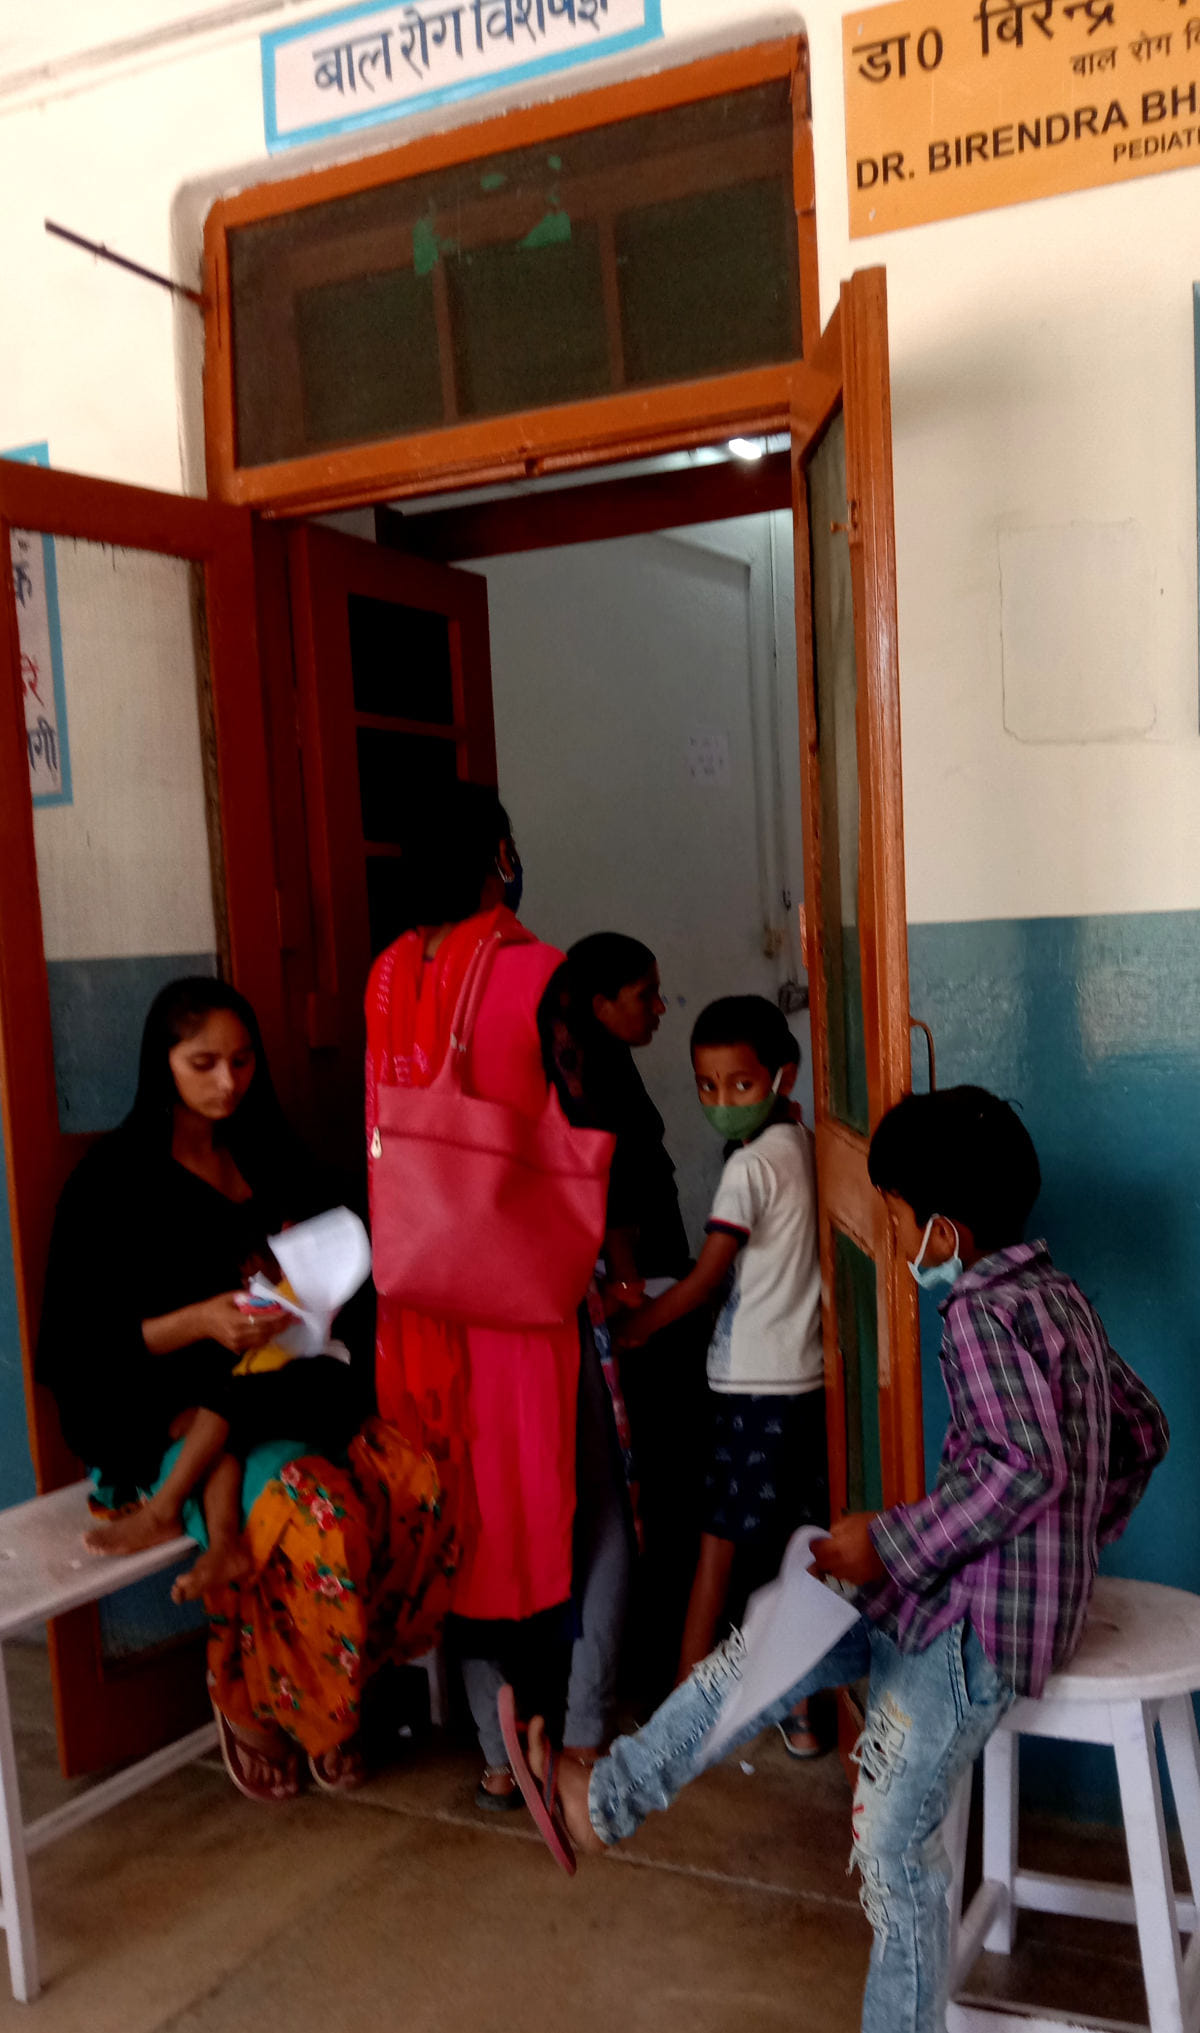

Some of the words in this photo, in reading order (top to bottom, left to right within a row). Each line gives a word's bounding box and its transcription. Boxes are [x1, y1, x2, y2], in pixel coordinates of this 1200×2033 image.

[312, 28, 393, 94] बाल
[400, 4, 464, 79] रोग
[1070, 46, 1118, 77] बाल
[1128, 30, 1172, 62] रोग
[856, 151, 915, 191] DR.
[928, 99, 1129, 175] BIRENDRA
[1141, 81, 1200, 126] BH
[1113, 126, 1200, 164] PEDIAT
